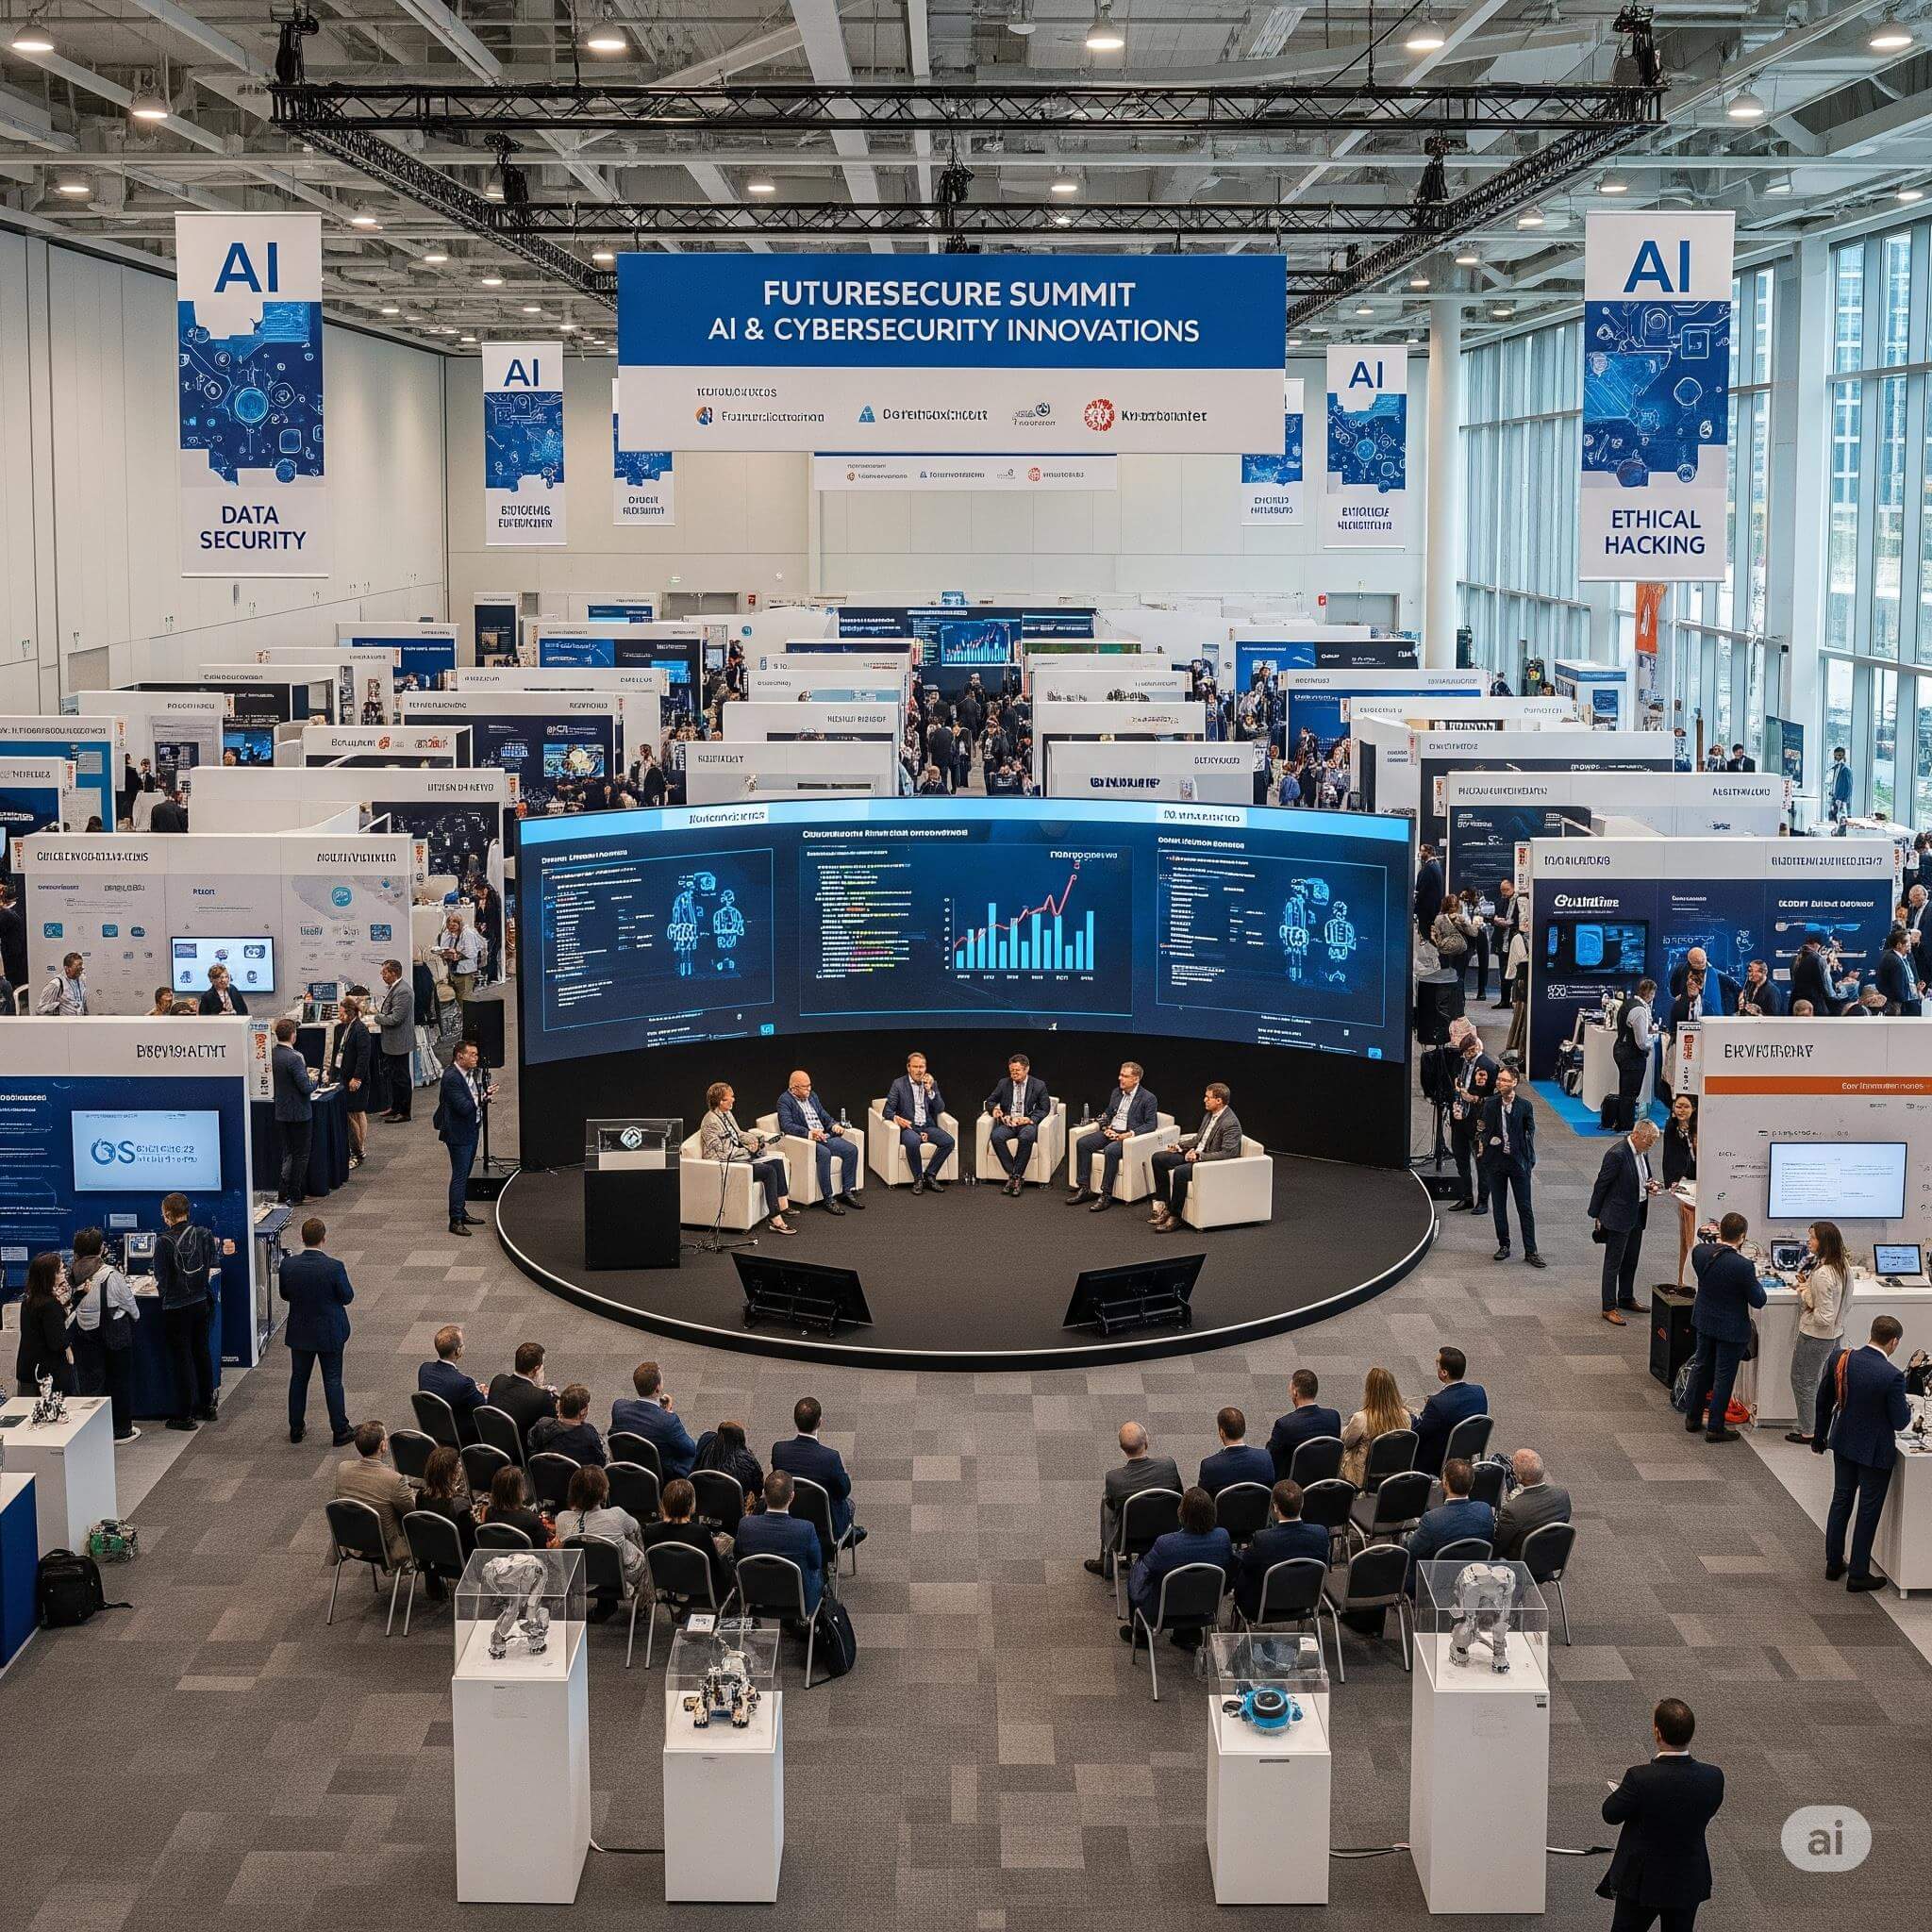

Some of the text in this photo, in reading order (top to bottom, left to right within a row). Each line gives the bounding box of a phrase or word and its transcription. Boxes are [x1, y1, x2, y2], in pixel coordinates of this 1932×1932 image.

[214, 242, 279, 293] AI
[1624, 241, 1690, 293] AI
[764, 281, 1137, 307] FUTURESECURE SUMMIT
[708, 317, 1200, 342] AI & CYBERSECURITY INNOVATIONS
[504, 358, 540, 388] AI
[1349, 360, 1383, 389] AI
[222, 505, 280, 525] DATA
[1612, 509, 1702, 529] ETHICAL
[200, 530, 307, 550] SECURITY
[1606, 536, 1706, 555] HACKING
